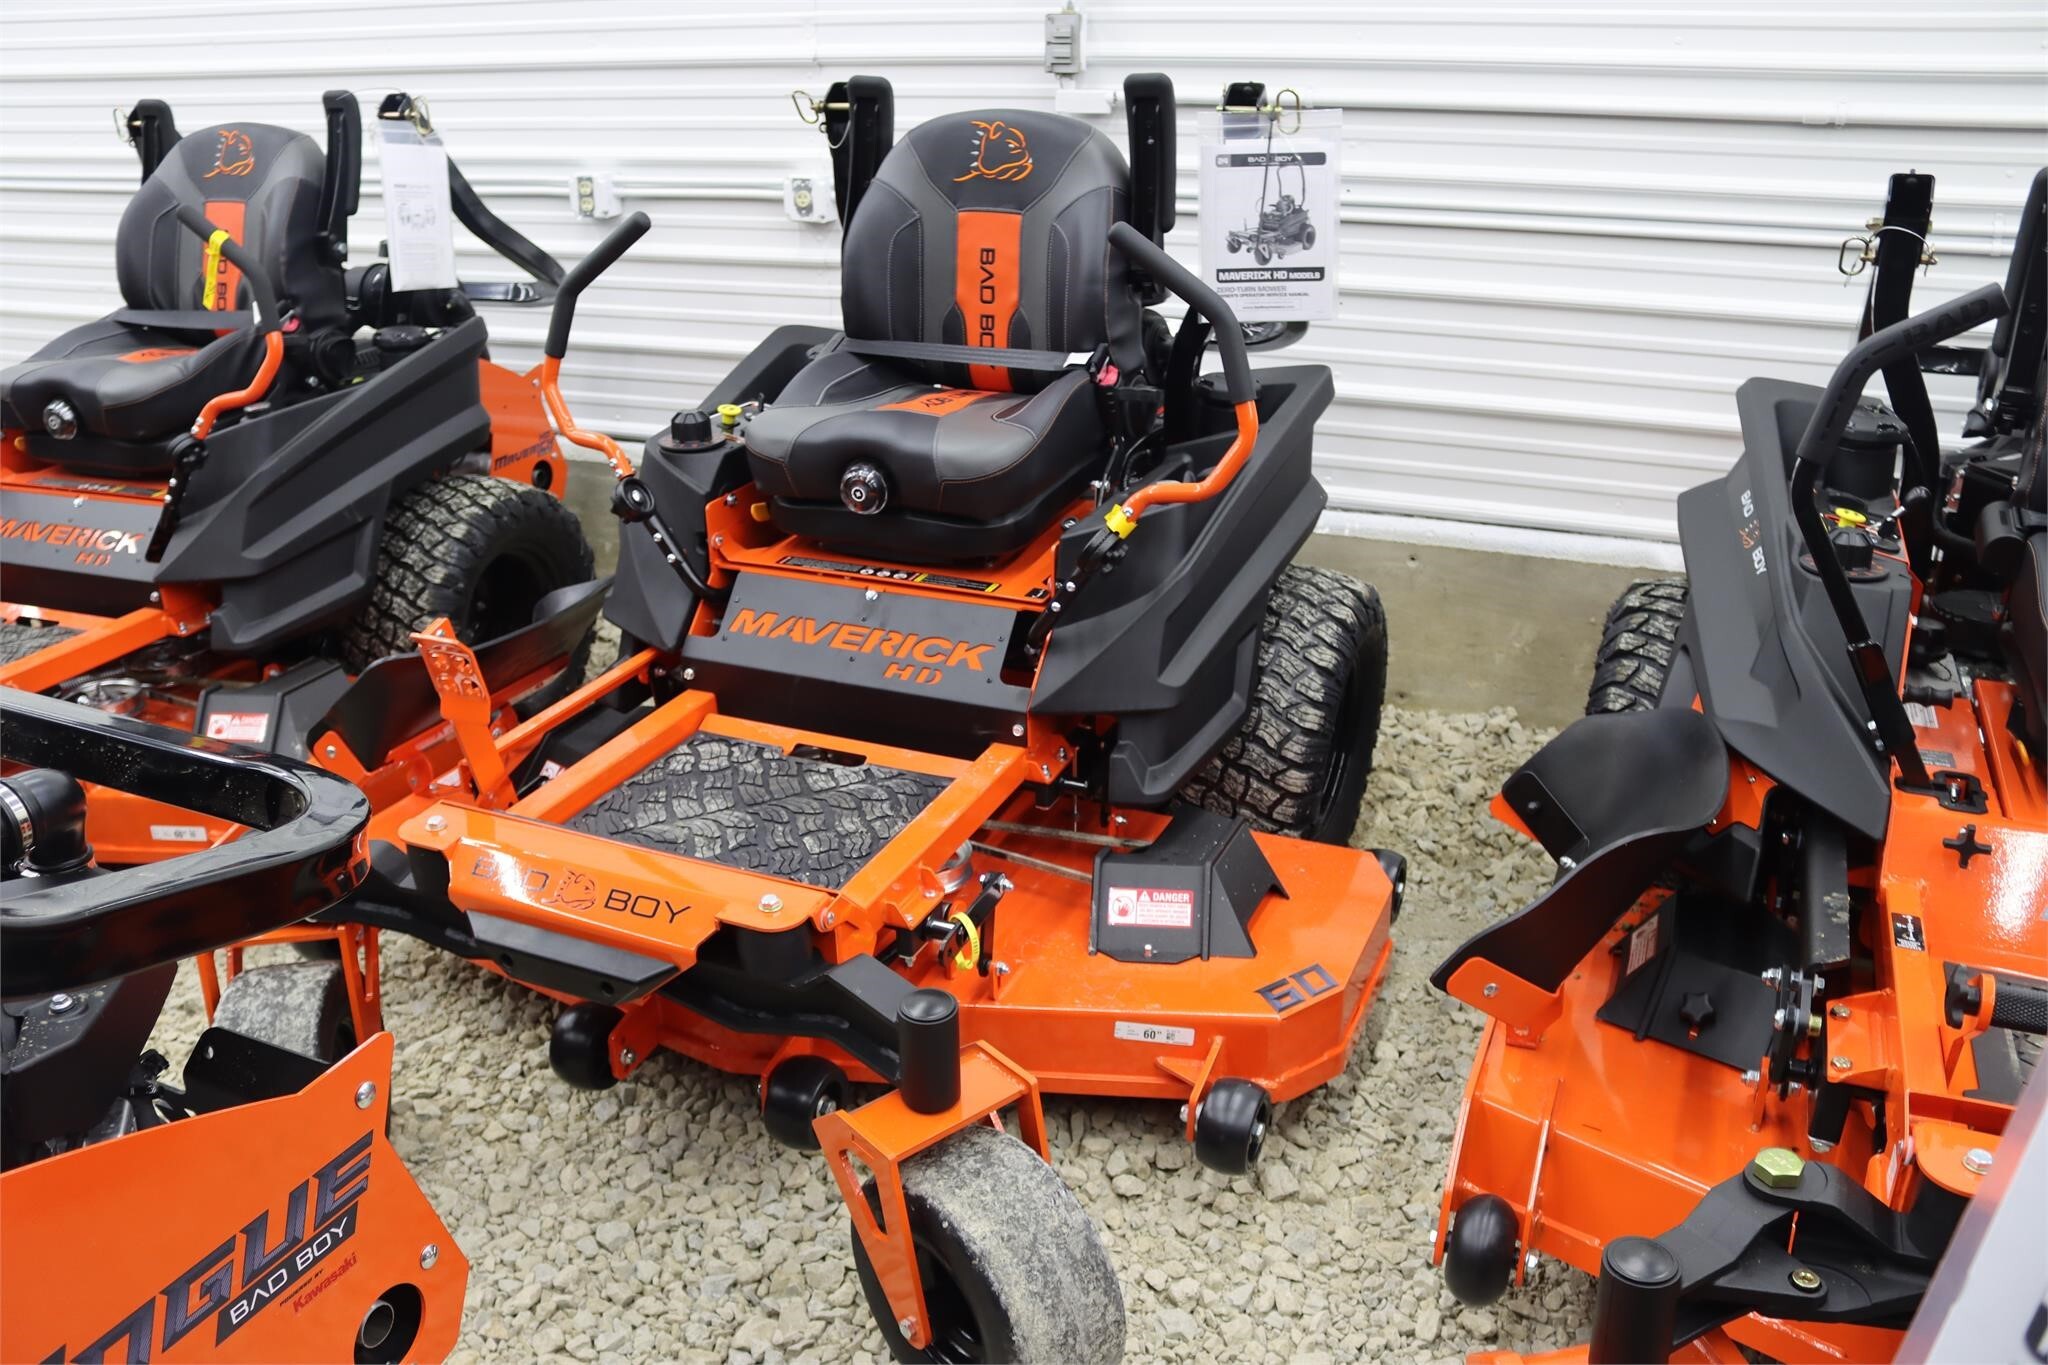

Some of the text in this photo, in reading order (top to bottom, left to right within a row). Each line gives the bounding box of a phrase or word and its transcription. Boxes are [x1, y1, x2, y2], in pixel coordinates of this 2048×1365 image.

[1274, 155, 1293, 163] BOY
[217, 283, 227, 311] BO
[979, 248, 996, 348] BAD BO
[1218, 270, 1321, 281] MAVERICK HD MODELS
[1741, 489, 1767, 575] BAD BOY
[74, 551, 112, 568] HD
[729, 608, 996, 671] MAVERICK
[882, 662, 944, 685] HD
[471, 855, 692, 924] BD BOY
[1152, 892, 1190, 903] DANGER
[1253, 962, 1340, 1014] 60
[38, 1128, 374, 1365] GUE
[229, 1216, 348, 1326] BAD BOY
[279, 1268, 324, 1307] POWERED BY
[292, 1251, 358, 1313] Kawasaki
